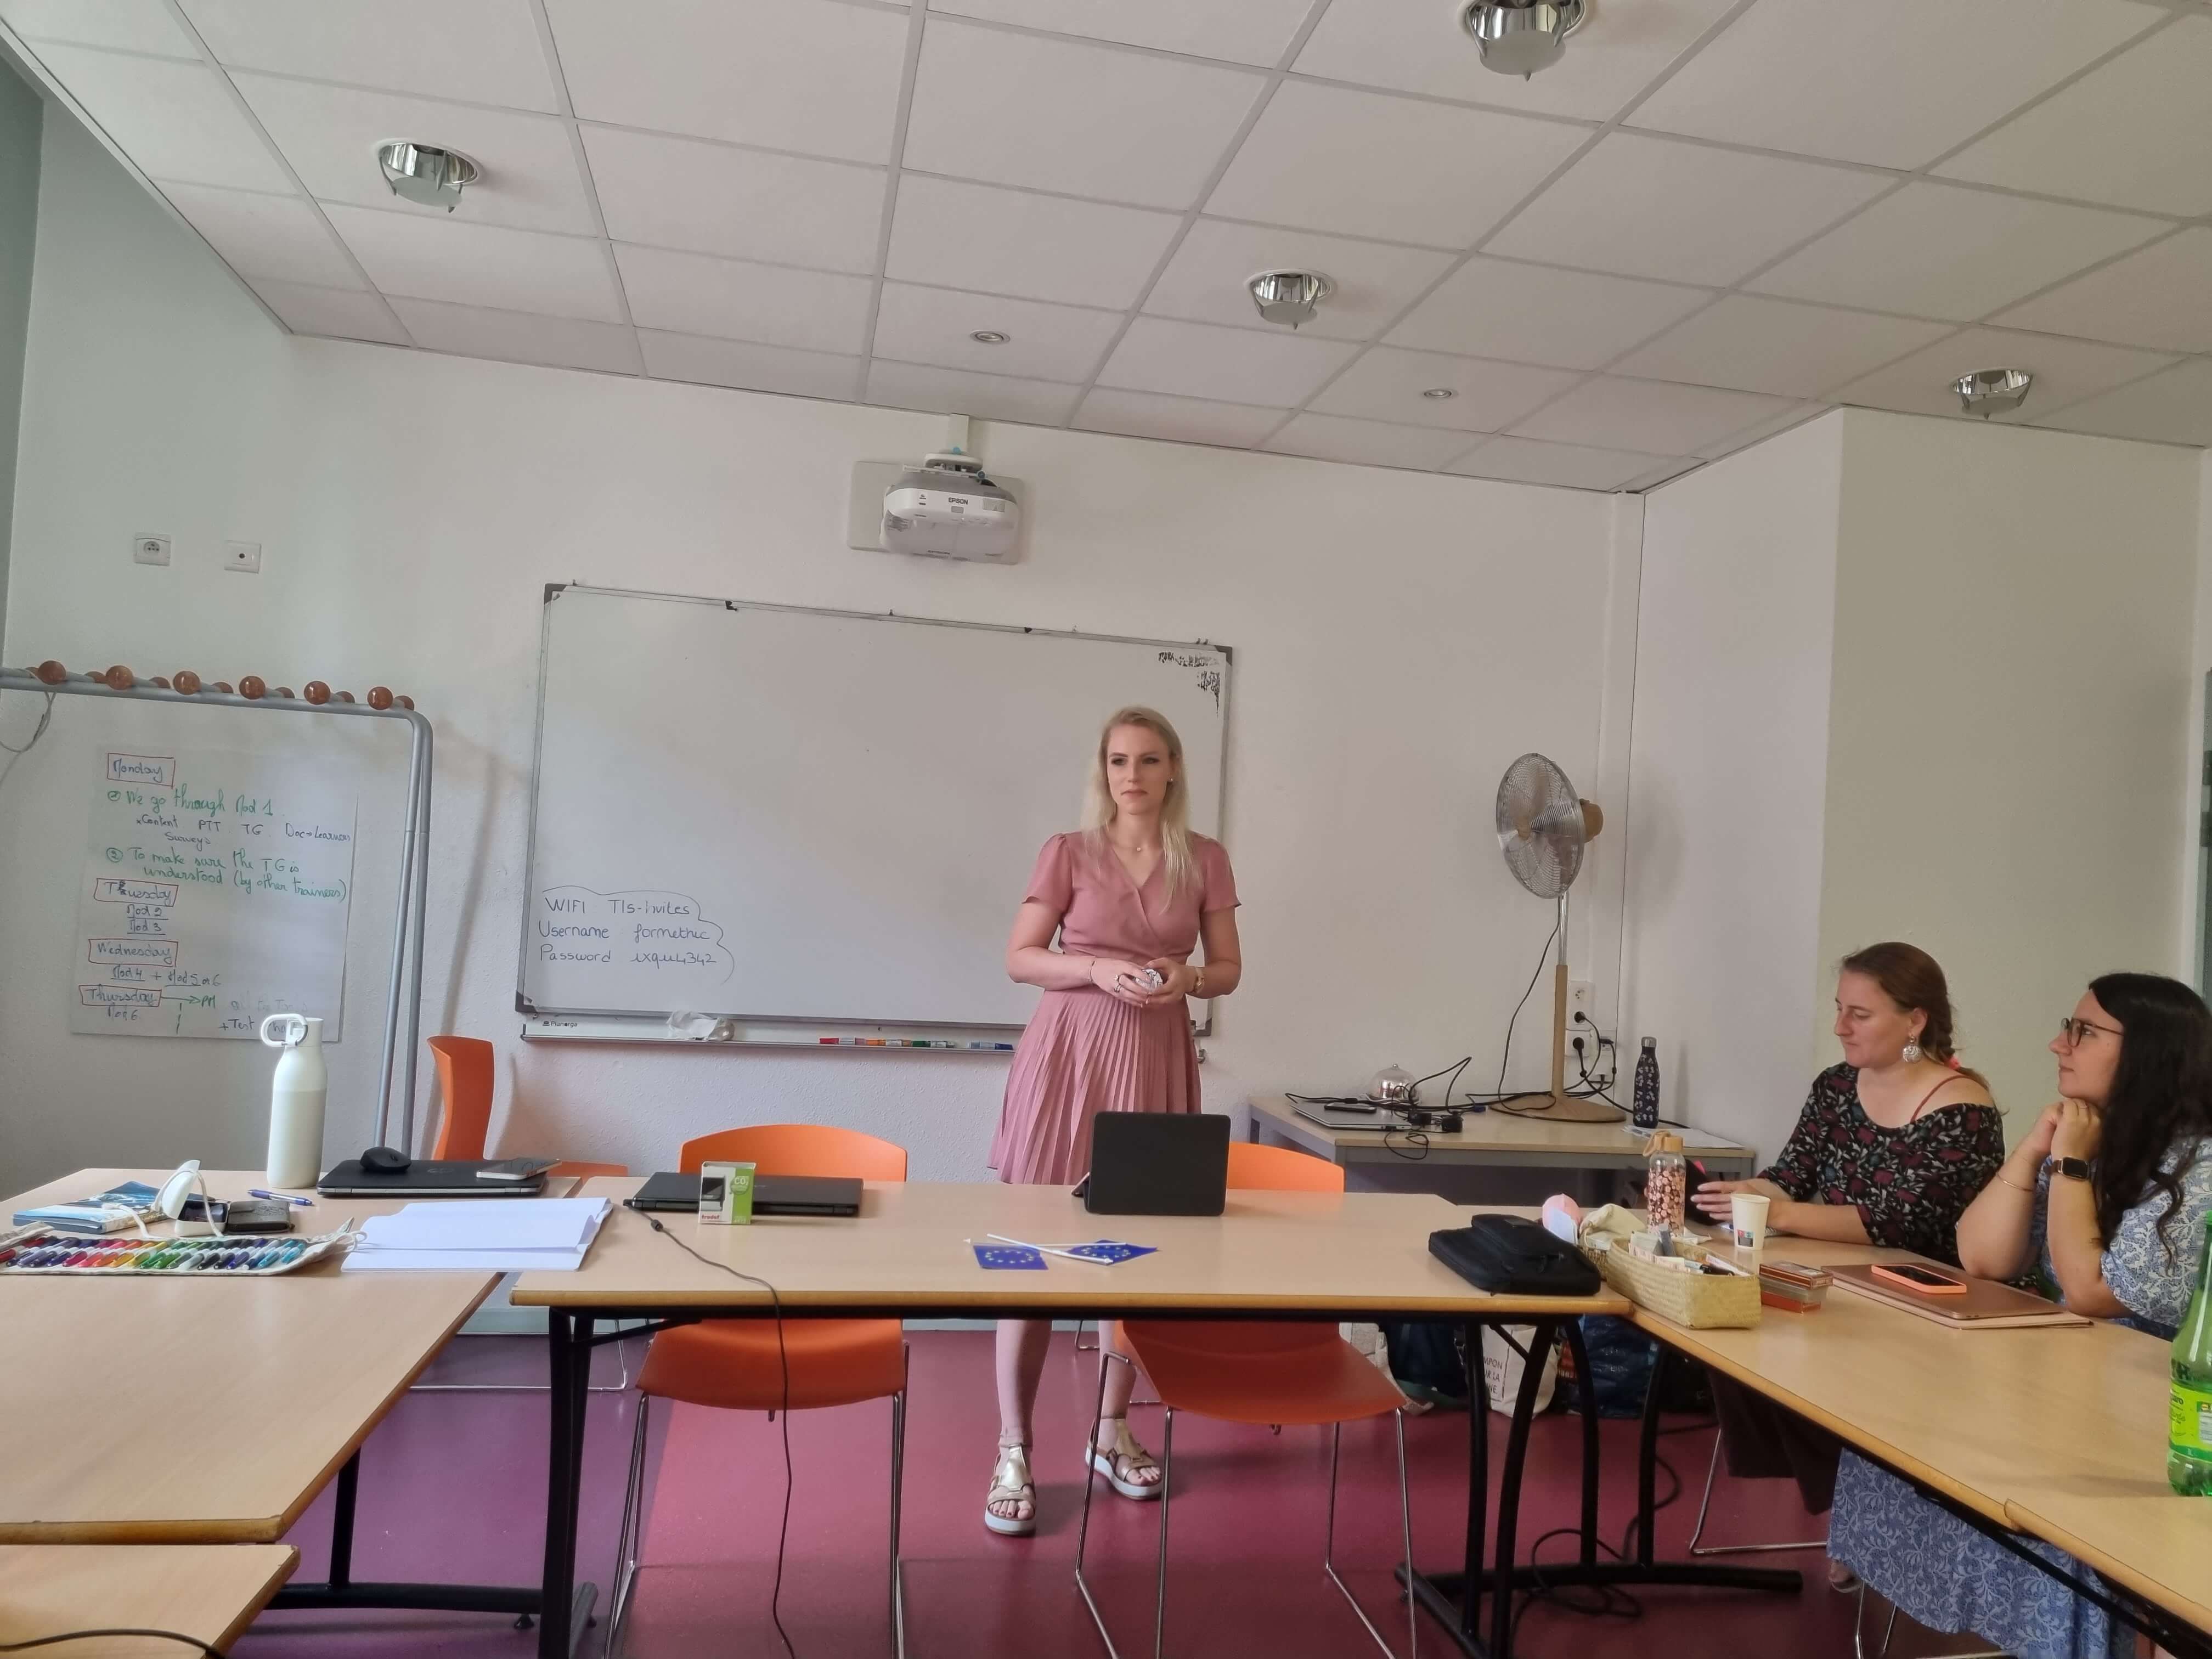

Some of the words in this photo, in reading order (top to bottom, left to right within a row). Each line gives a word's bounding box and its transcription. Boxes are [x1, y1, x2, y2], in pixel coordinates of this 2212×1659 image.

[114, 758, 163, 783] Monday
[127, 788, 143, 804] We
[151, 797, 166, 813] go
[174, 783, 225, 817] through
[236, 794, 256, 816] Mod
[262, 799, 273, 816] 1
[199, 820, 221, 832] PTT
[241, 824, 263, 835] TG
[165, 832, 211, 851] Surveys
[127, 847, 145, 860] To
[152, 847, 185, 865] make
[195, 857, 226, 868] sure
[233, 848, 253, 869] the
[260, 859, 285, 872] TG
[290, 861, 299, 872] is
[144, 867, 223, 884] understood
[234, 870, 251, 894] (by
[257, 873, 287, 891] other
[292, 877, 346, 903] trainers)
[127, 904, 150, 918] Mod
[154, 907, 162, 916] 2
[129, 919, 148, 932] Mod
[154, 923, 162, 932] 3
[539, 919, 610, 939] Username
[98, 942, 172, 964] Wednesday
[540, 944, 611, 963] Password
[113, 965, 133, 978] Mod
[136, 969, 142, 979] 4
[168, 970, 187, 984] Mod
[84, 984, 157, 1006] Thursday
[131, 1009, 138, 1020] 6
[1483, 1356, 1503, 1370] MPON
